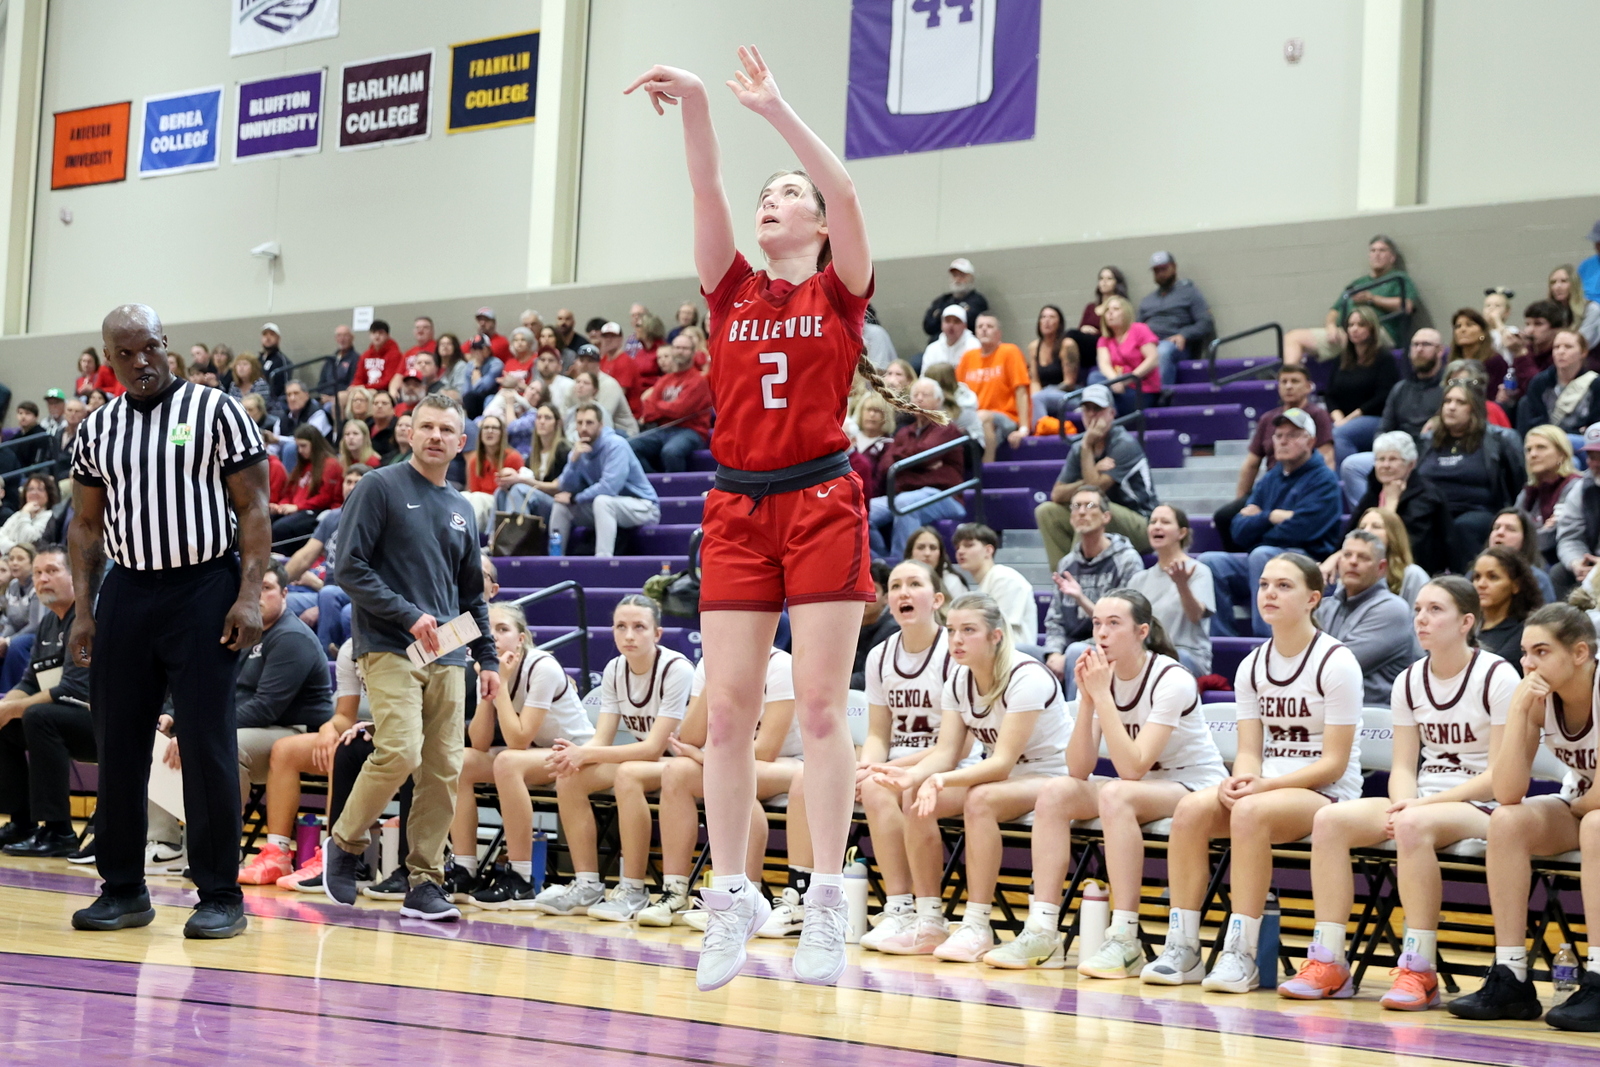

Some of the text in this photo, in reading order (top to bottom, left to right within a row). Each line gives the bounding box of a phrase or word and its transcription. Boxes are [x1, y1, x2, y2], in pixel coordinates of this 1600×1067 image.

[469, 51, 530, 79] FRANKLIN
[347, 70, 424, 103] EARLHAM
[465, 82, 529, 109] COLLEGE
[249, 91, 311, 116] BLUFFTON
[70, 123, 112, 141] ANDERSON
[159, 109, 203, 132] BEREA
[239, 113, 318, 140] UNIVERSITY
[345, 103, 420, 134] COLLEGE
[150, 129, 209, 154] COLLEGE
[65, 150, 113, 169] UNIVERSITY
[728, 315, 822, 342] BELLEVUE
[759, 352, 788, 409] 2
[888, 689, 933, 708] GENOA
